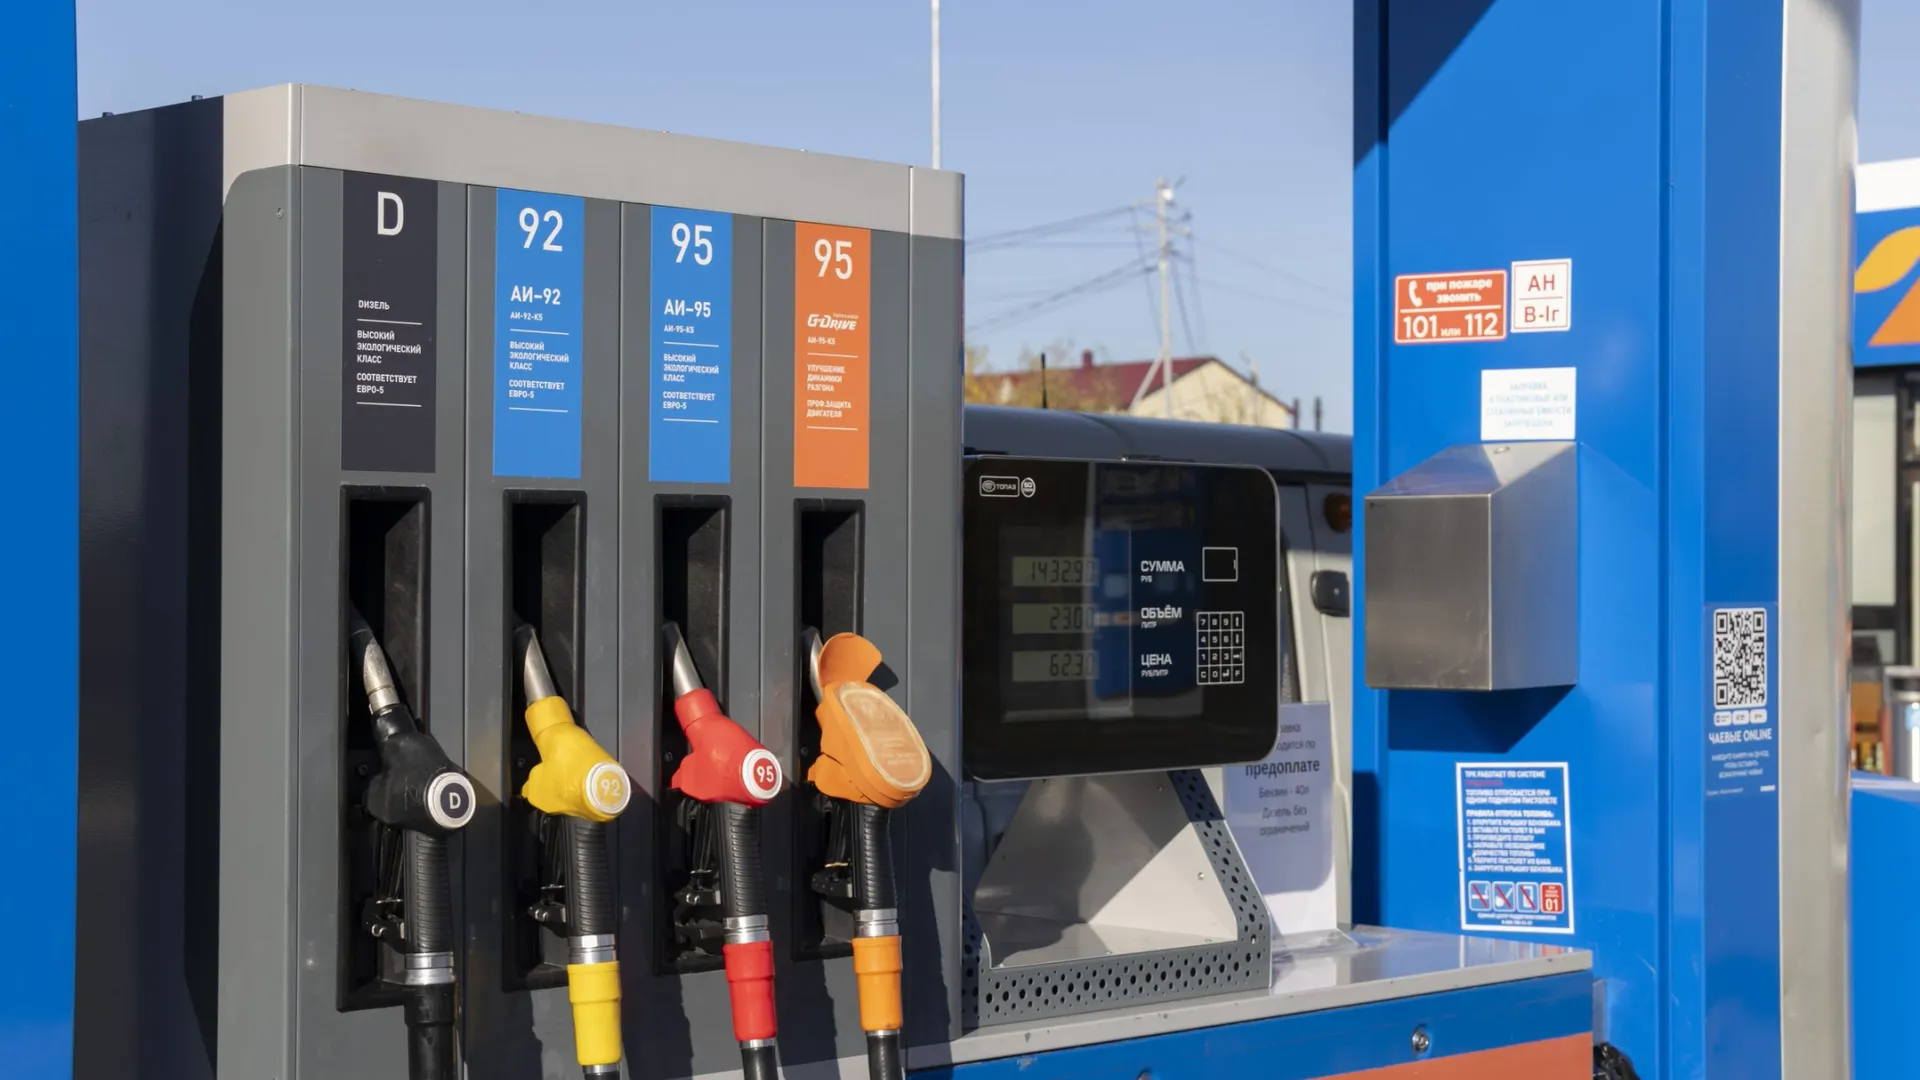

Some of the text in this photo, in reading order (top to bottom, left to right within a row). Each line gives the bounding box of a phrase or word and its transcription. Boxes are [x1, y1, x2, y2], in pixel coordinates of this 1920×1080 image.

[377, 191, 404, 236] D
[518, 207, 563, 252] 92
[671, 222, 713, 265] 95
[814, 238, 853, 280] 95
[1426, 278, 1492, 292] при пожаре
[1436, 293, 1481, 304] звонить
[1403, 312, 1498, 338] 101 или 112
[356, 328, 395, 341] ВЫСОКИЙ
[356, 342, 422, 355] ЭКОЛОГИЧЕСКИЙ
[509, 340, 545, 351] ВЫСОКИЙ
[356, 354, 382, 365] КЛАСС
[509, 351, 570, 363] ЭКОЛОГИЧЕСКИЙ
[663, 353, 696, 364] ВЫСОКИЙ
[509, 362, 533, 372] КЛАСС
[663, 363, 719, 375] ЭКОЛОГИЧЕСКИЙ
[807, 364, 846, 374] УЛУЧШЕНИЕ
[356, 372, 417, 384] СООТВЕТСТВУЕТ
[663, 373, 685, 383] КЛАСС
[807, 373, 842, 383] ДИНАМИКИ
[356, 385, 385, 395] ЕВРО-5
[508, 379, 565, 391] СООТВЕТСТВУЕТ
[807, 383, 834, 392] РАЗГОНА
[508, 389, 535, 399] ЕВРО-5
[662, 390, 716, 402] СООТВЕТСТВУЕТ
[662, 401, 687, 410] ЕВРО-5
[806, 408, 842, 418] ДВИГАТЕЛЯ
[1140, 560, 1185, 573] СУММА
[1140, 575, 1152, 583] РУБ
[1140, 604, 1182, 619] ОБЪЁМ
[1141, 621, 1157, 629] ЛИТР
[1200, 618, 1206, 626] 7
[1223, 618, 1229, 626] 9
[1140, 654, 1173, 667] ЦЕНА
[1223, 652, 1229, 660] 3
[1708, 728, 1773, 744] ЧАЕВЫЕ ONLINE
[1305, 740, 1316, 749] по
[756, 765, 773, 783] 95
[1245, 760, 1320, 779] предоплате
[600, 779, 620, 796] 92
[1259, 787, 1288, 798] Бензин
[449, 792, 461, 810] D
[1262, 804, 1307, 819] Дизель без
[1259, 821, 1310, 836] ограничений
[1545, 898, 1558, 911] 01
